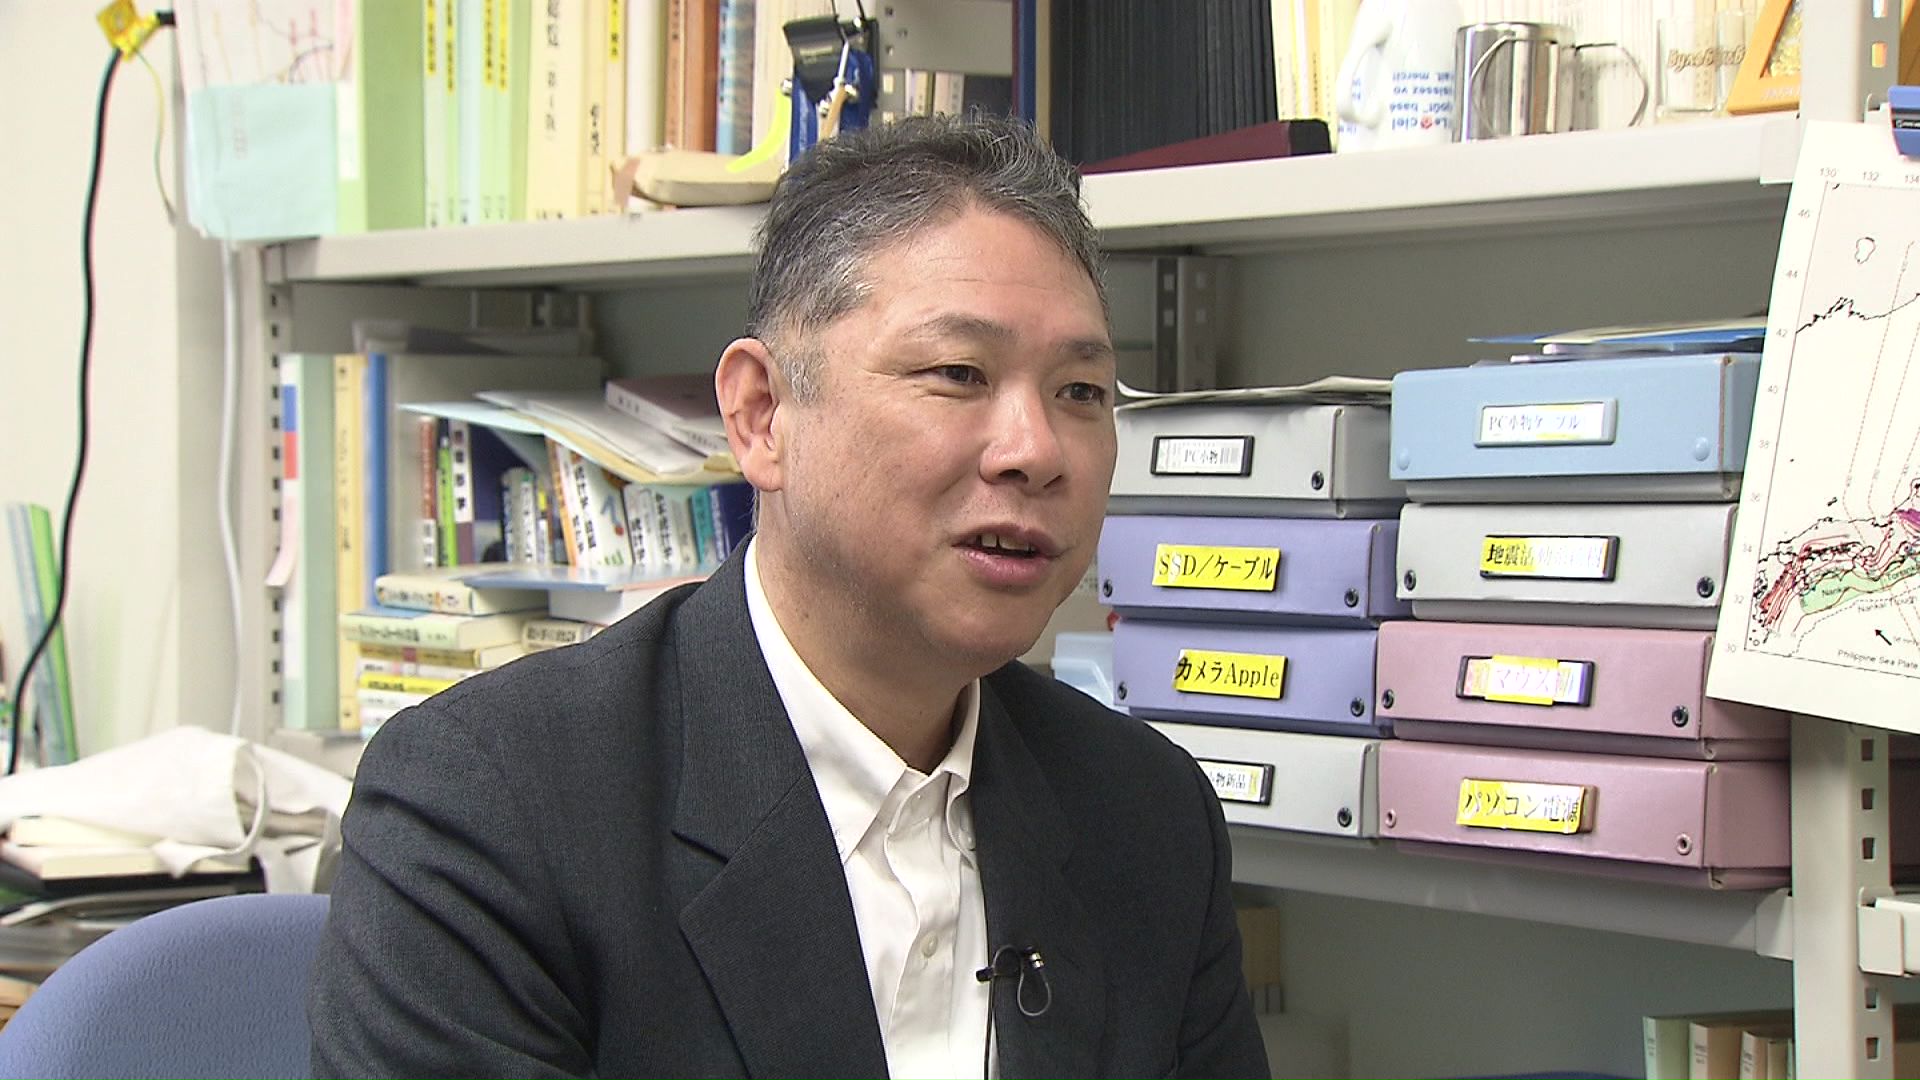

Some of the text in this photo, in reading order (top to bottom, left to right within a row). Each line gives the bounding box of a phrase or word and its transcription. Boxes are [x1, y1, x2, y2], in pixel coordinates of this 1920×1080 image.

[1819, 167, 1837, 178] 130
[1862, 171, 1880, 182] 132
[1158, 553, 1273, 580] SSD/ケーブル
[1174, 657, 1280, 688] カメラApple
